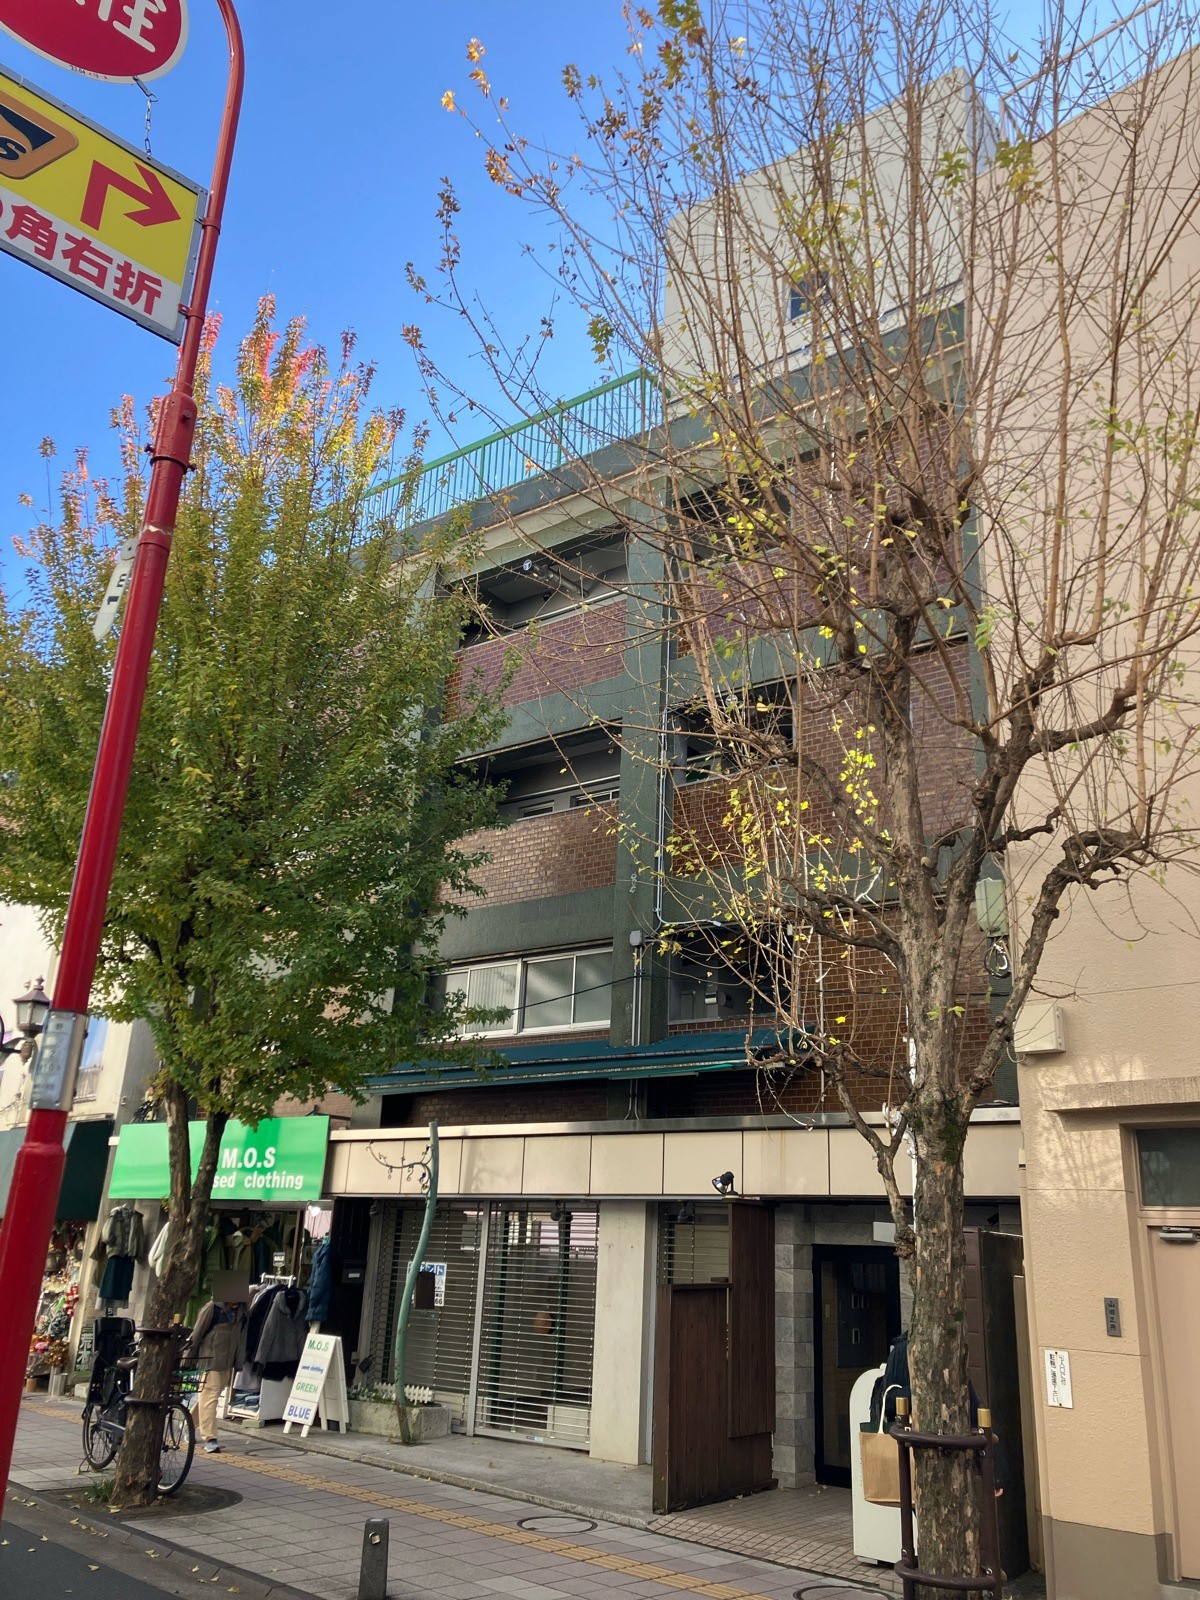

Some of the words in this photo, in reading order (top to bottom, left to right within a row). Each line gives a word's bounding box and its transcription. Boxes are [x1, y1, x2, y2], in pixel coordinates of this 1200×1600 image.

[0, 198, 163, 316] 角右折
[221, 1147, 276, 1169] M.O.S
[212, 1171, 237, 1189] sed
[243, 1170, 304, 1190] clothing
[307, 1339, 330, 1352] M.O.S
[295, 1381, 319, 1394] GREEN
[287, 1404, 312, 1420] BLUE
